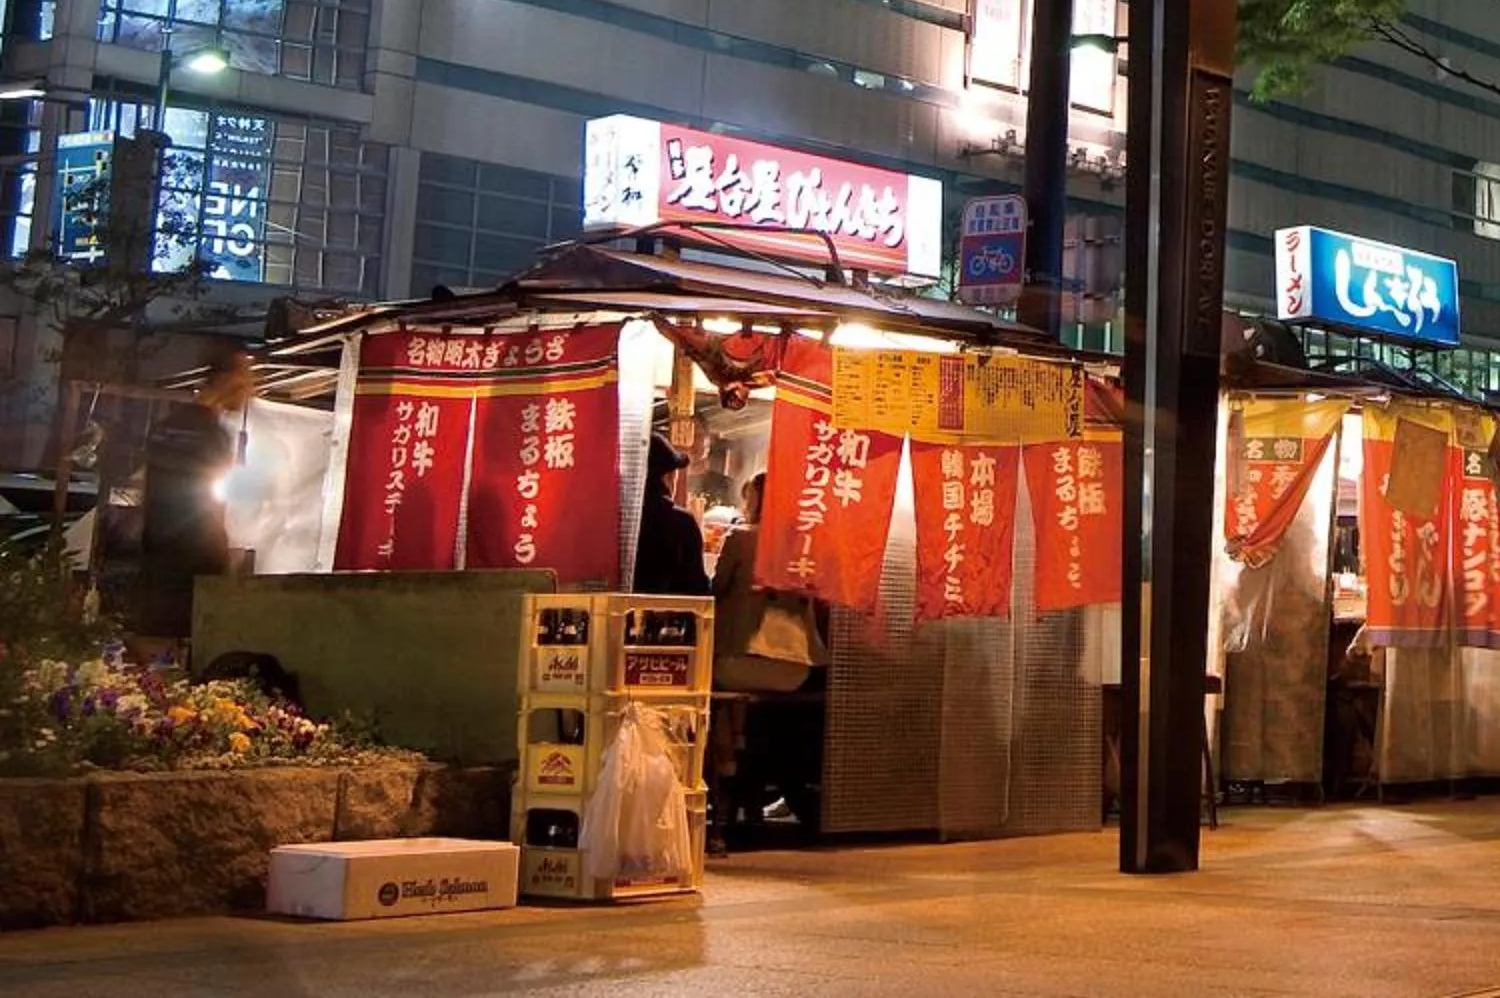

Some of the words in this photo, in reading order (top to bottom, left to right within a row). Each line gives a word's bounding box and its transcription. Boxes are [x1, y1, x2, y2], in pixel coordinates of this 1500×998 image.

[1286, 231, 1303, 315] ラーメン
[407, 333, 567, 369] 名物明太ぎょうざ
[412, 402, 439, 477] 和牛
[544, 398, 576, 470] 鉄板
[832, 429, 869, 508] 和牛
[514, 404, 544, 564] まるちょう
[970, 450, 997, 527] 本場
[627, 654, 688, 672] アサヒビール
